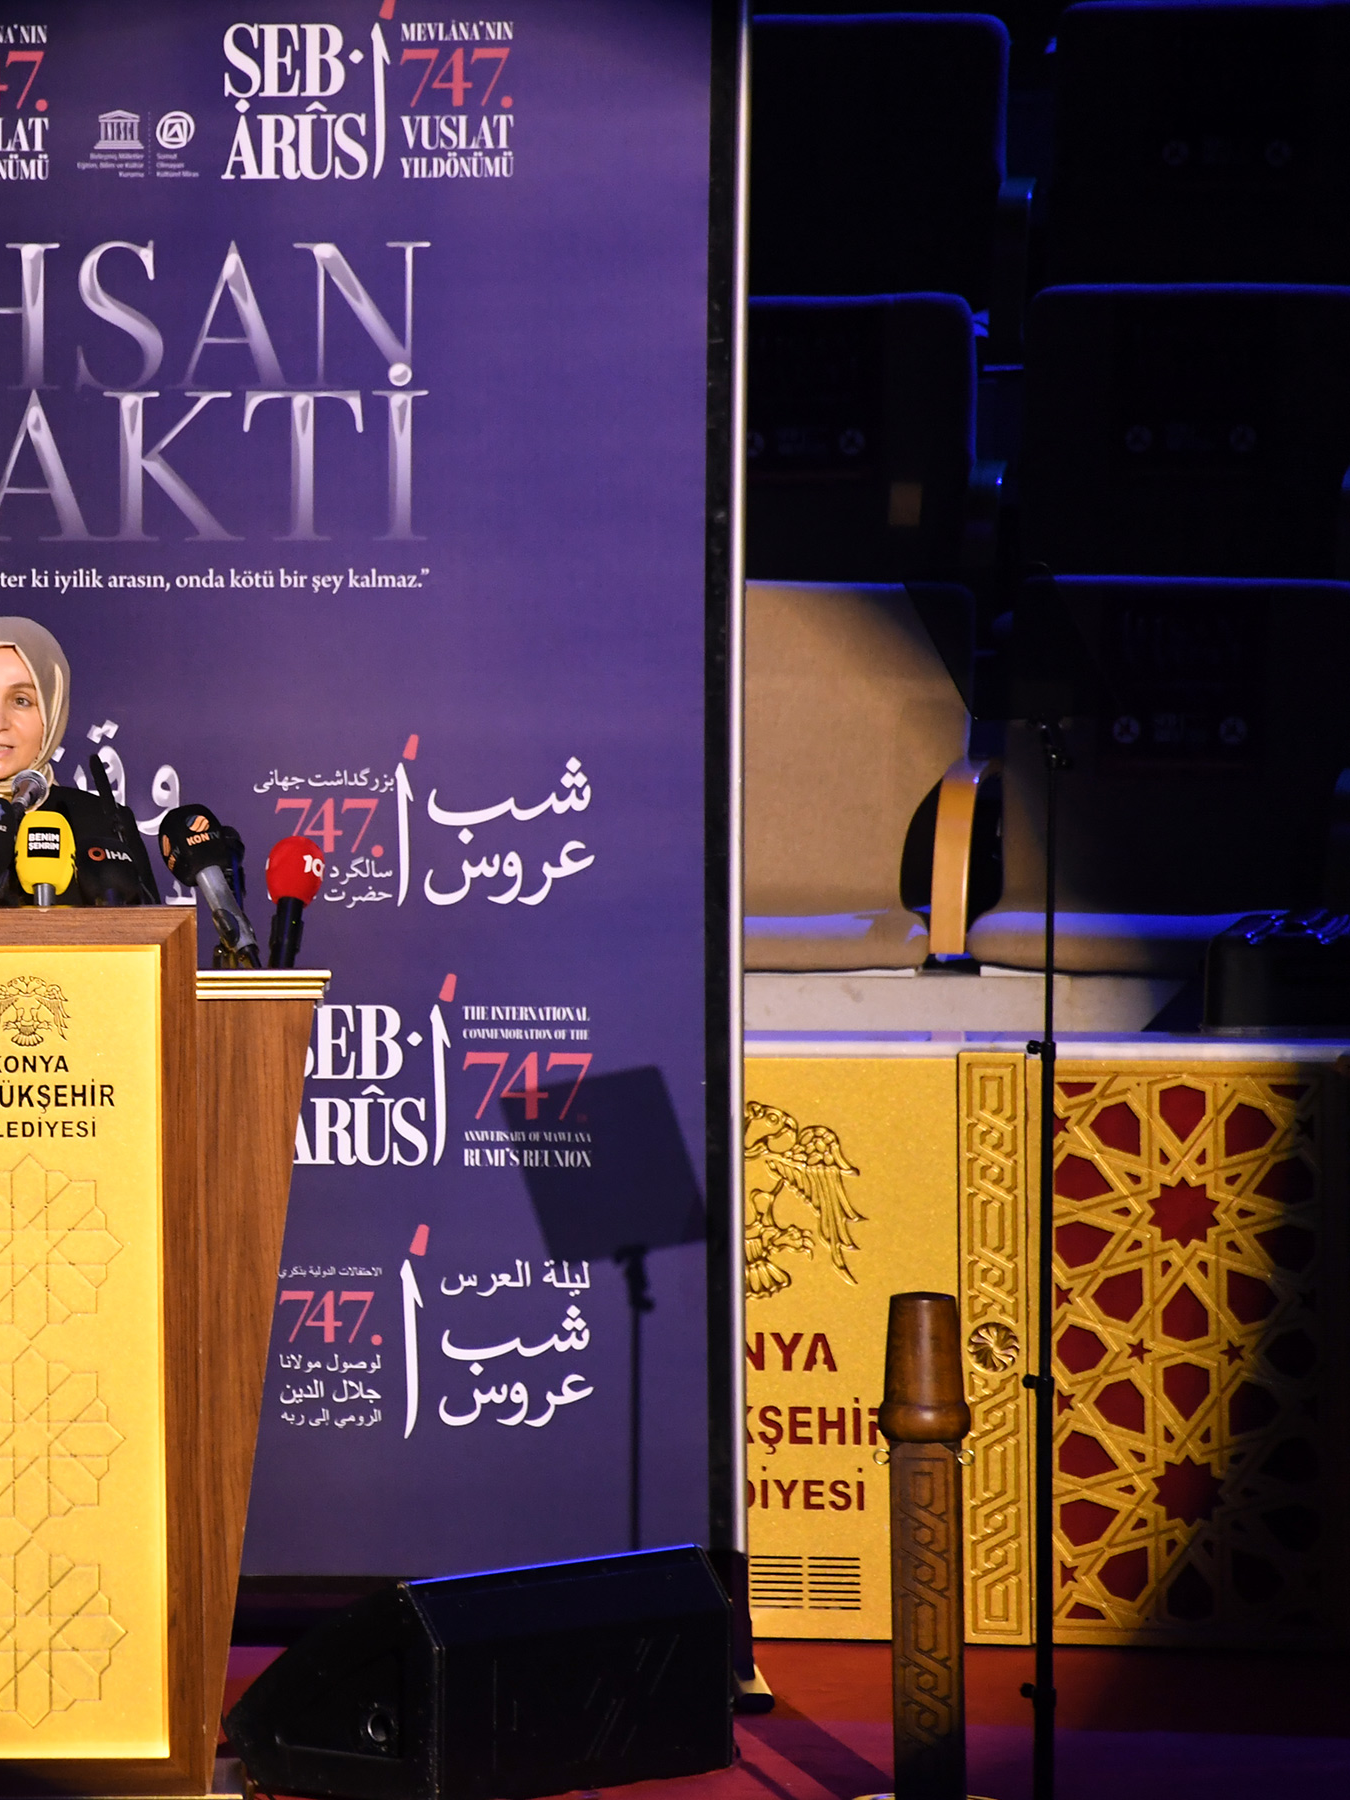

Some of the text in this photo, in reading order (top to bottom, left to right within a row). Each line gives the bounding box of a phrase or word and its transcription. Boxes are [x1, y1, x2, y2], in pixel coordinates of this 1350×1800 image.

[399, 47, 513, 109] 747.
[400, 114, 515, 150] VUSLAT
[400, 151, 515, 179] YILDÖNÜMÜ
[31, 568, 49, 588] ki
[54, 568, 104, 594] iyilik
[107, 574, 171, 592] arasın,
[175, 568, 225, 588] onda
[229, 568, 275, 588] kötü
[279, 568, 308, 588] bir
[311, 573, 344, 594] şey
[426, 756, 592, 845] شب
[423, 840, 596, 906] عروس
[323, 886, 393, 908] حضرت
[462, 1005, 591, 1022] THE INTERNATIONAL
[462, 1028, 590, 1041] COMMEMORATION OF THE
[464, 1130, 527, 1142] ANNIVERSARY
[528, 1131, 541, 1142] OF
[523, 1149, 592, 1168] REUNION
[440, 1259, 591, 1297] ليلة العرس
[278, 1290, 383, 1346] 747.
[440, 1304, 590, 1376] شب
[746, 1332, 838, 1372] NYA
[279, 1353, 382, 1374] لوصول مولانا
[279, 1379, 382, 1405] جلال الدين
[438, 1373, 595, 1427] عروس
